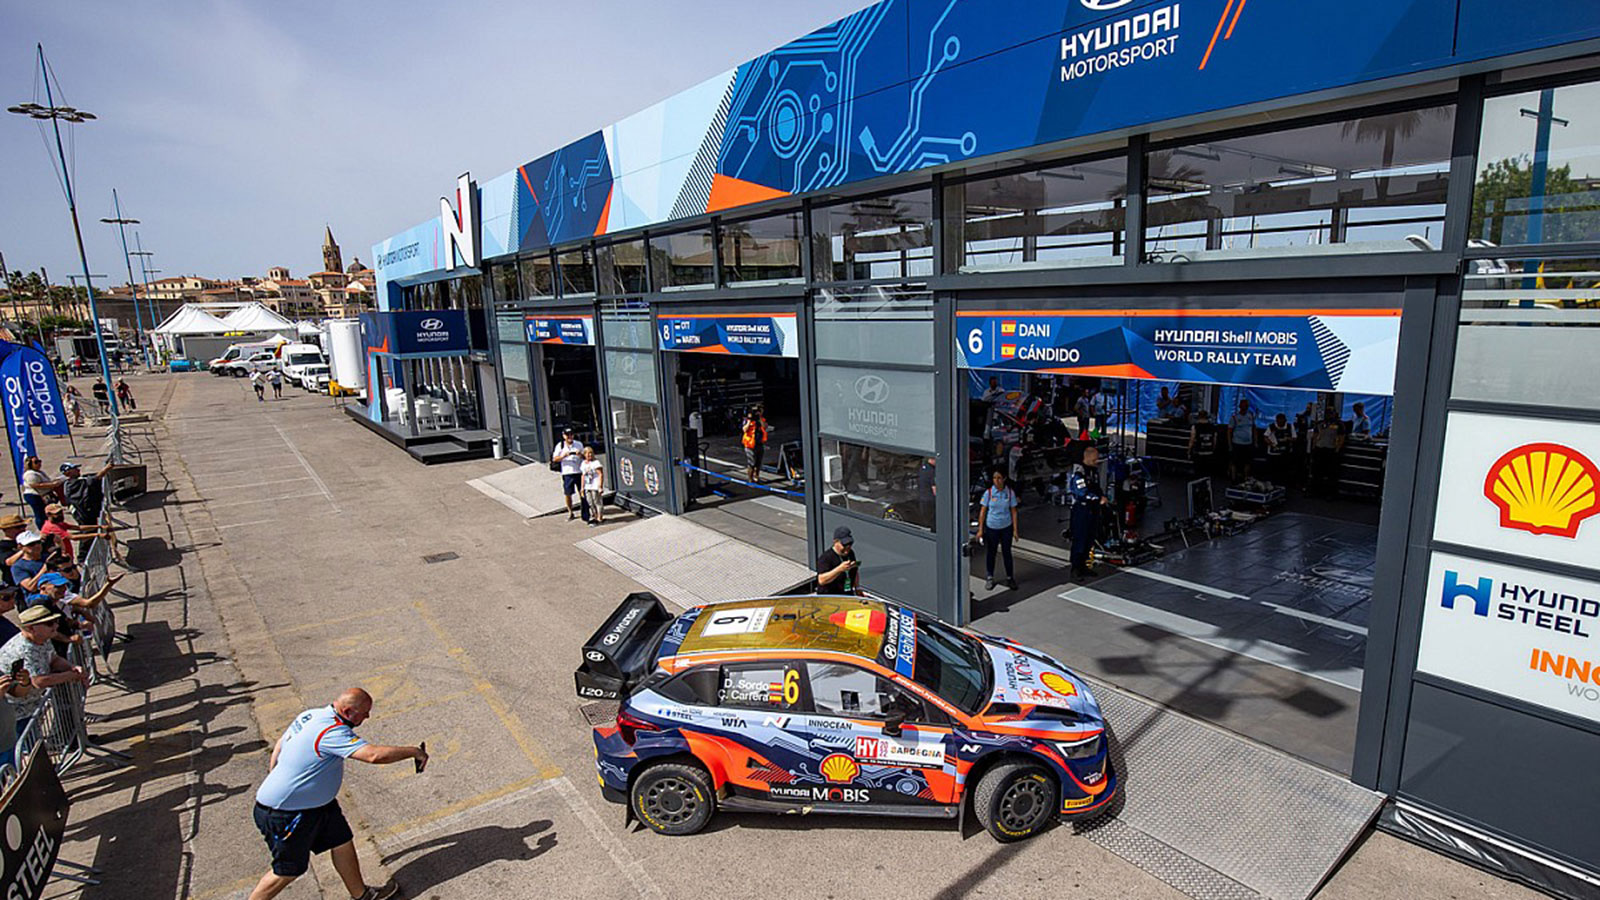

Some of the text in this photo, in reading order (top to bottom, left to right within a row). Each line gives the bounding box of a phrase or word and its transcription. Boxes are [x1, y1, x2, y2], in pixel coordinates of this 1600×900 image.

[1061, 4, 1180, 61] HYUNDAI
[1061, 35, 1180, 82] MOTORSPORT
[663, 324, 671, 341] 8
[1019, 324, 1050, 337] DANI
[1154, 329, 1298, 345] HYUNDAI Shell MOBIS
[727, 335, 743, 343] WORLD
[757, 336, 771, 344] TEAM
[968, 328, 983, 354] 6
[1018, 343, 1080, 363] CÁNDIDO
[1154, 350, 1297, 367] WORLD RALLY TEAM
[848, 407, 899, 426] HYUNDAI
[848, 422, 899, 440] MOTORSPORT
[1498, 603, 1589, 638] STEEL
[724, 678, 769, 690] D. Sordo
[784, 669, 799, 704] 6
[731, 690, 768, 702] Carrera
[671, 711, 693, 720] STEEL
[721, 717, 748, 728] WIA
[808, 719, 853, 730] INNOCEAN
[857, 738, 878, 758] HY
[891, 745, 942, 758] SARDEGNA
[812, 787, 870, 802] MOBIS
